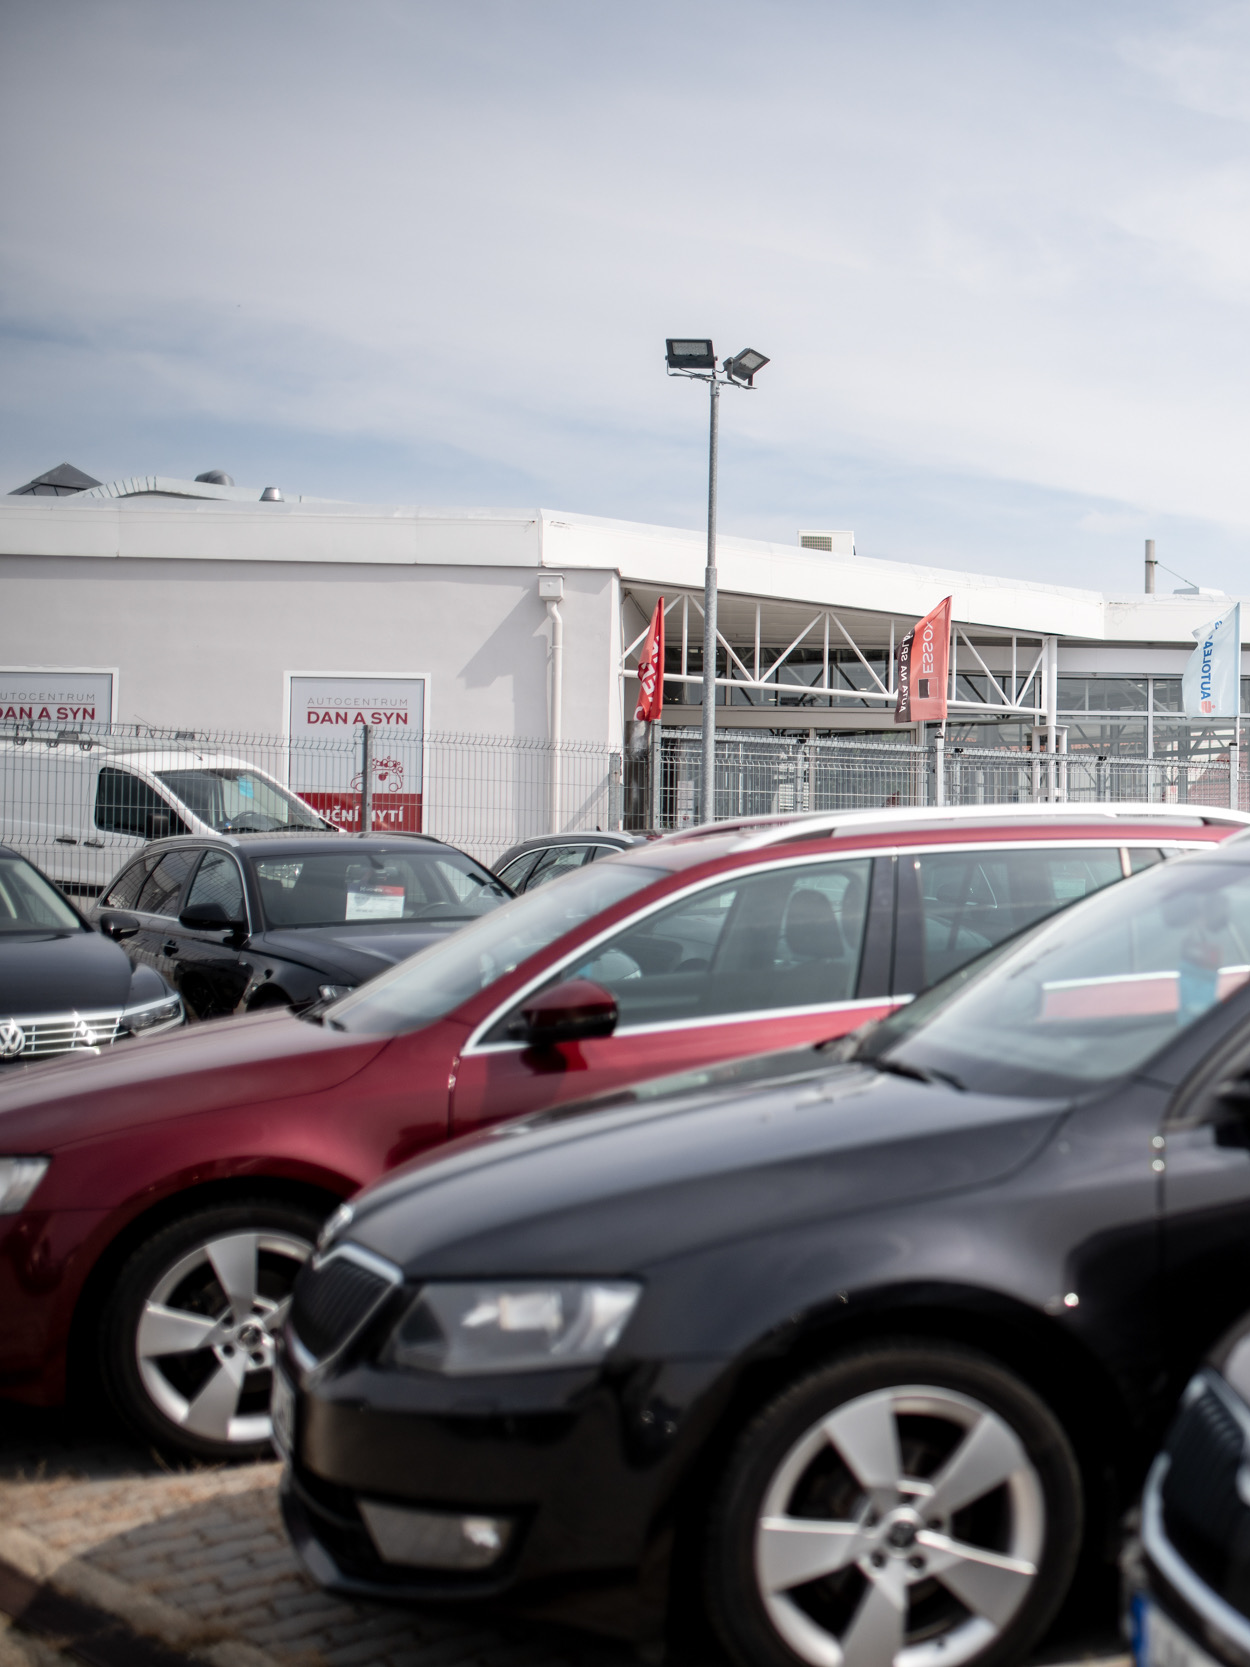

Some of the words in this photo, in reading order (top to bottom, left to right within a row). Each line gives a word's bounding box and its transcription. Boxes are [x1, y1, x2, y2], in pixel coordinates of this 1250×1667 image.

[0, 692, 95, 702] UTOCENTRUM
[307, 697, 408, 707] AUTOCENTRUM
[0, 706, 33, 720] AN
[37, 706, 51, 720] A
[56, 707, 95, 721] SYN
[307, 711, 348, 725] DAN
[352, 711, 367, 725] A
[370, 712, 408, 726] SYN
[318, 805, 360, 822] UČNÍ
